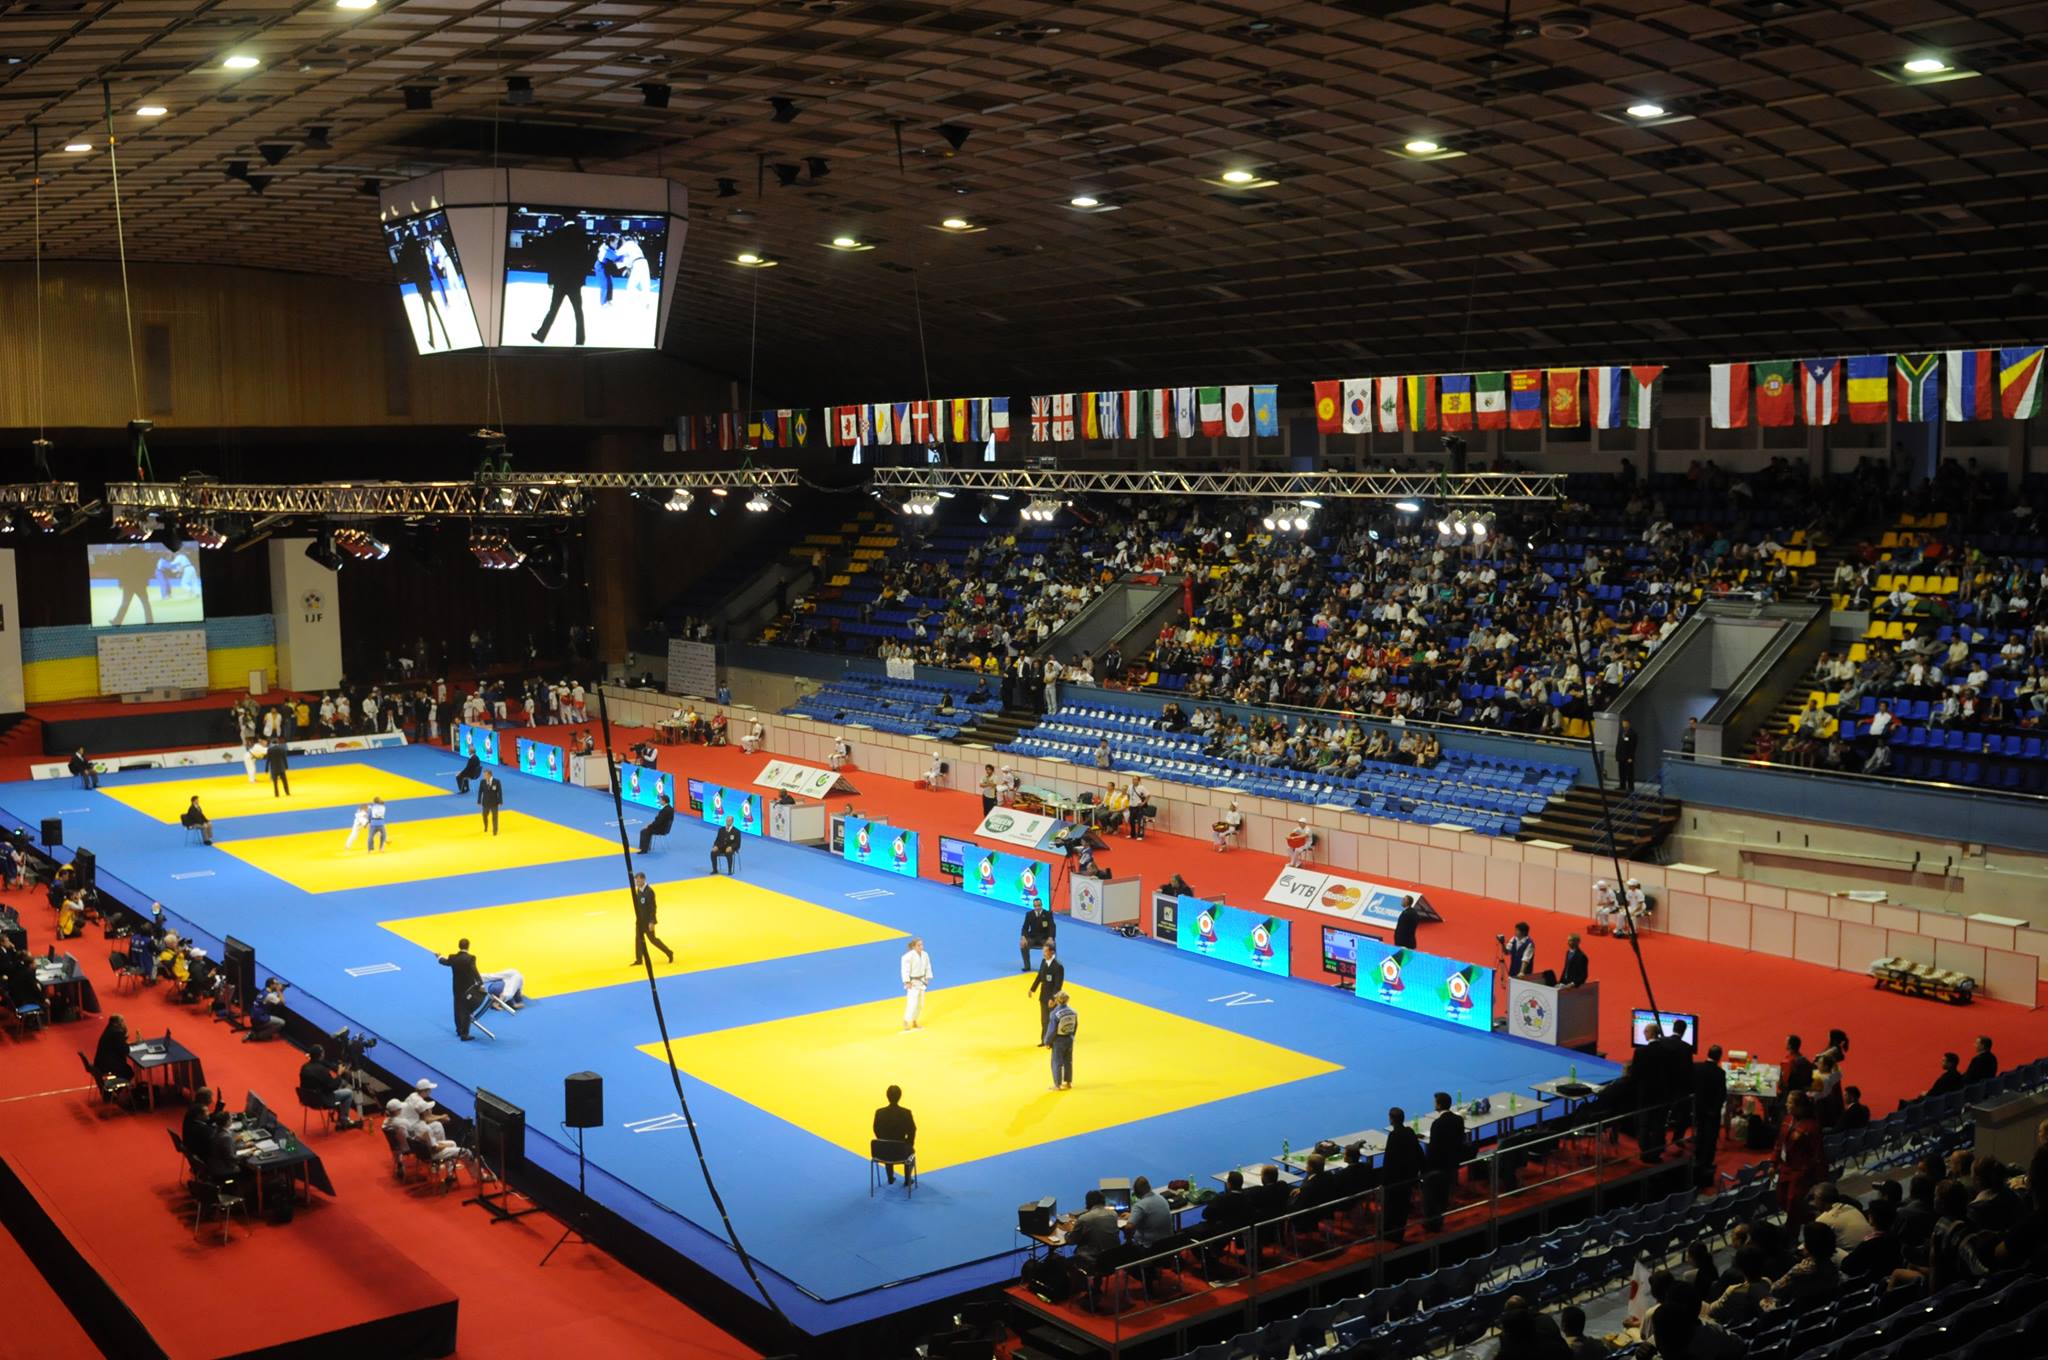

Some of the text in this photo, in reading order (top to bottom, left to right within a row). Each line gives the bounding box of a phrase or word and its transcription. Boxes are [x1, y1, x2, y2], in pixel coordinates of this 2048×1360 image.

[305, 613, 323, 623] IJF
[1290, 882, 1316, 898] VTB
[1207, 991, 1275, 1007] IV
